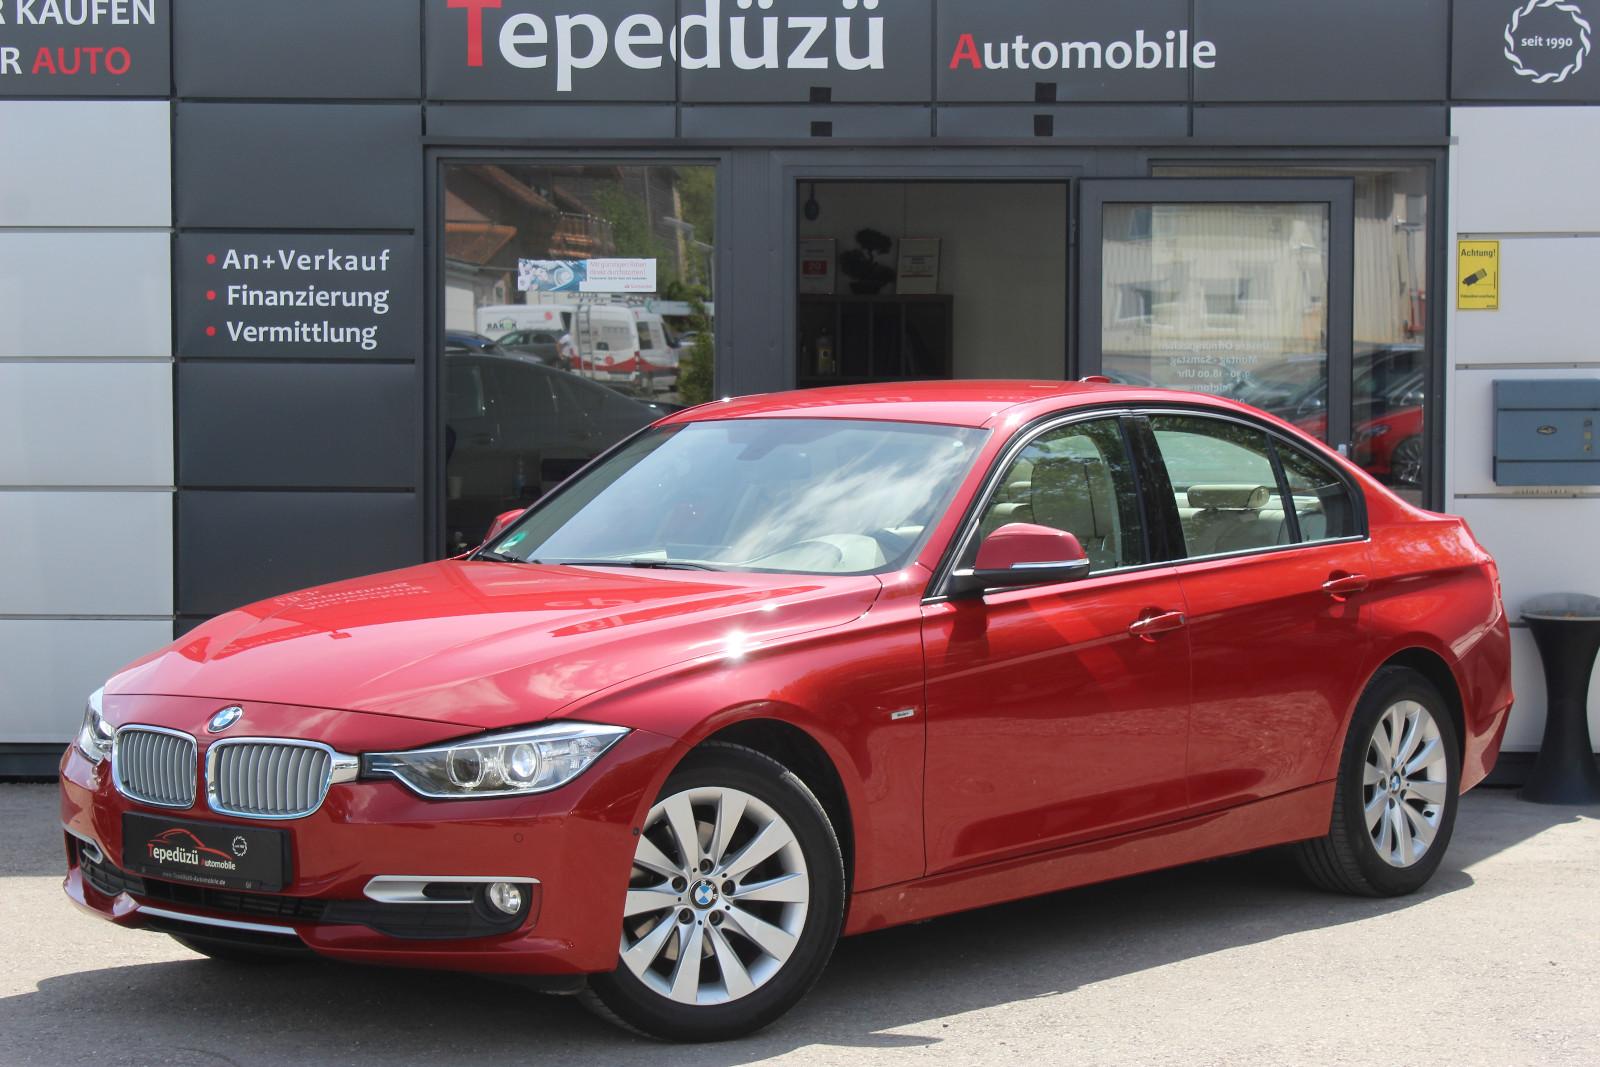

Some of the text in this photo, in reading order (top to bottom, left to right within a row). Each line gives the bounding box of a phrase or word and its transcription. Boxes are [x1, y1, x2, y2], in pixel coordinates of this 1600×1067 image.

[16, 0, 155, 25] KAUFEN
[447, 0, 1217, 92] Tepedüzü Automobile
[1521, 35, 1574, 49] seit 1990
[32, 47, 131, 75] AUTO
[222, 248, 390, 271] An+Verkauf
[1460, 248, 1496, 259] Achtung!
[227, 284, 390, 315] Finanzierung
[226, 320, 378, 351] Vermittlung
[146, 843, 236, 870] Tepedüzü Automobile
